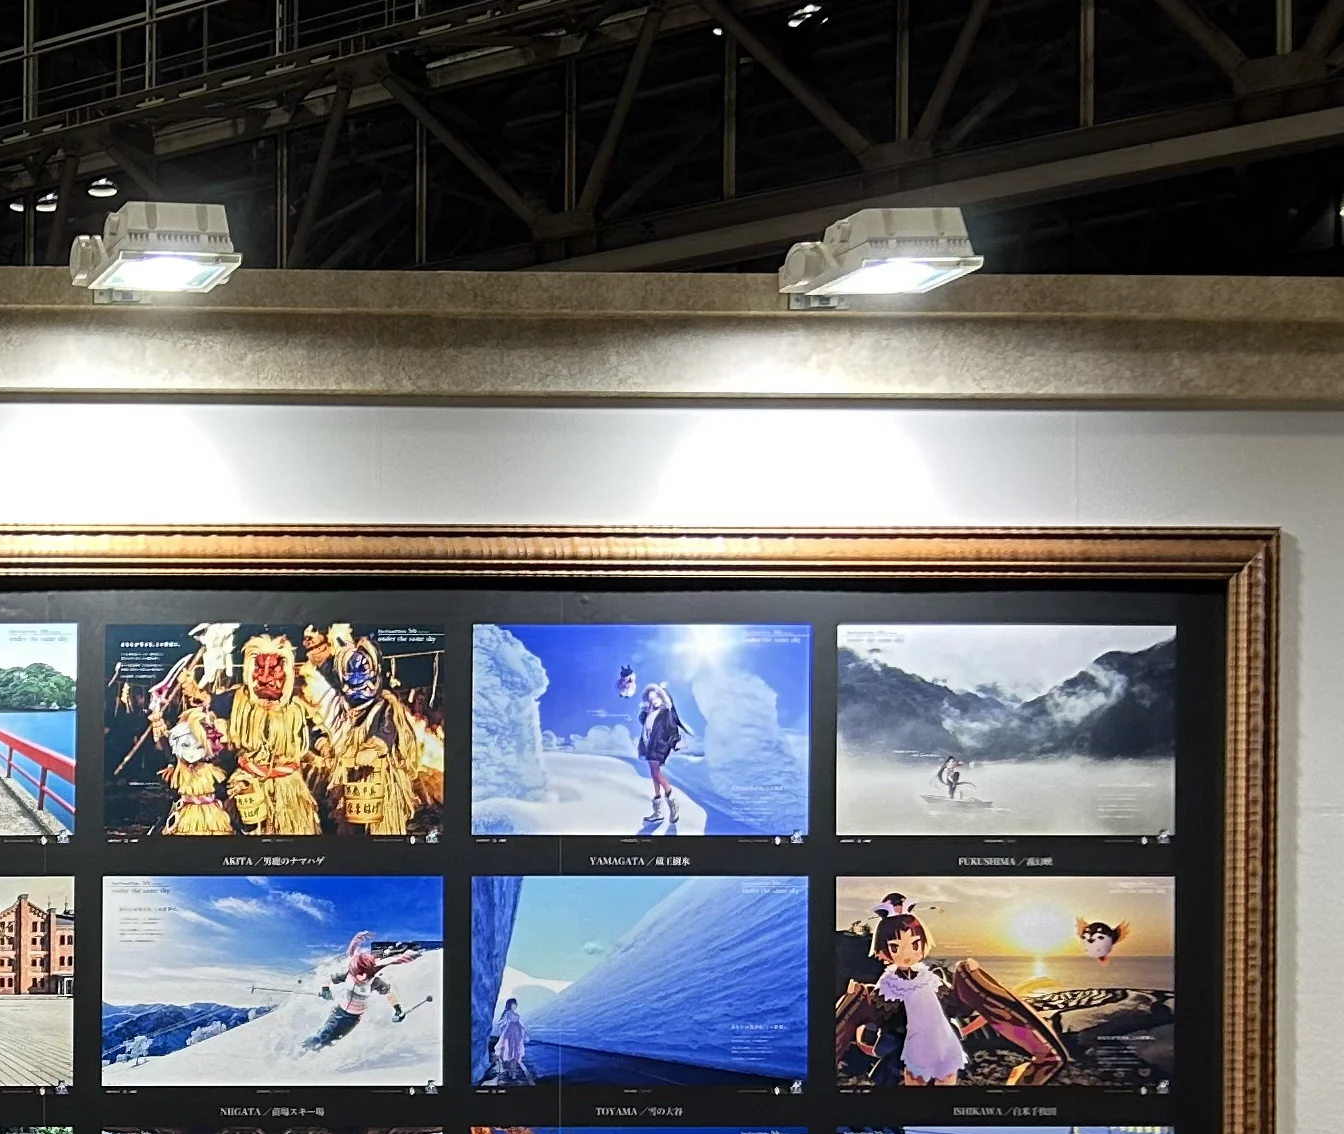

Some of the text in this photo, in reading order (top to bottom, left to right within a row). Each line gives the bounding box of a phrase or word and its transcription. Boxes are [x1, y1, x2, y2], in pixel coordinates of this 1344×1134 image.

[221, 856, 253, 866] AKITA
[589, 856, 645, 866] YAMAGATA
[220, 1107, 262, 1116] NIIGATA
[595, 1107, 638, 1116] TOYAMA
